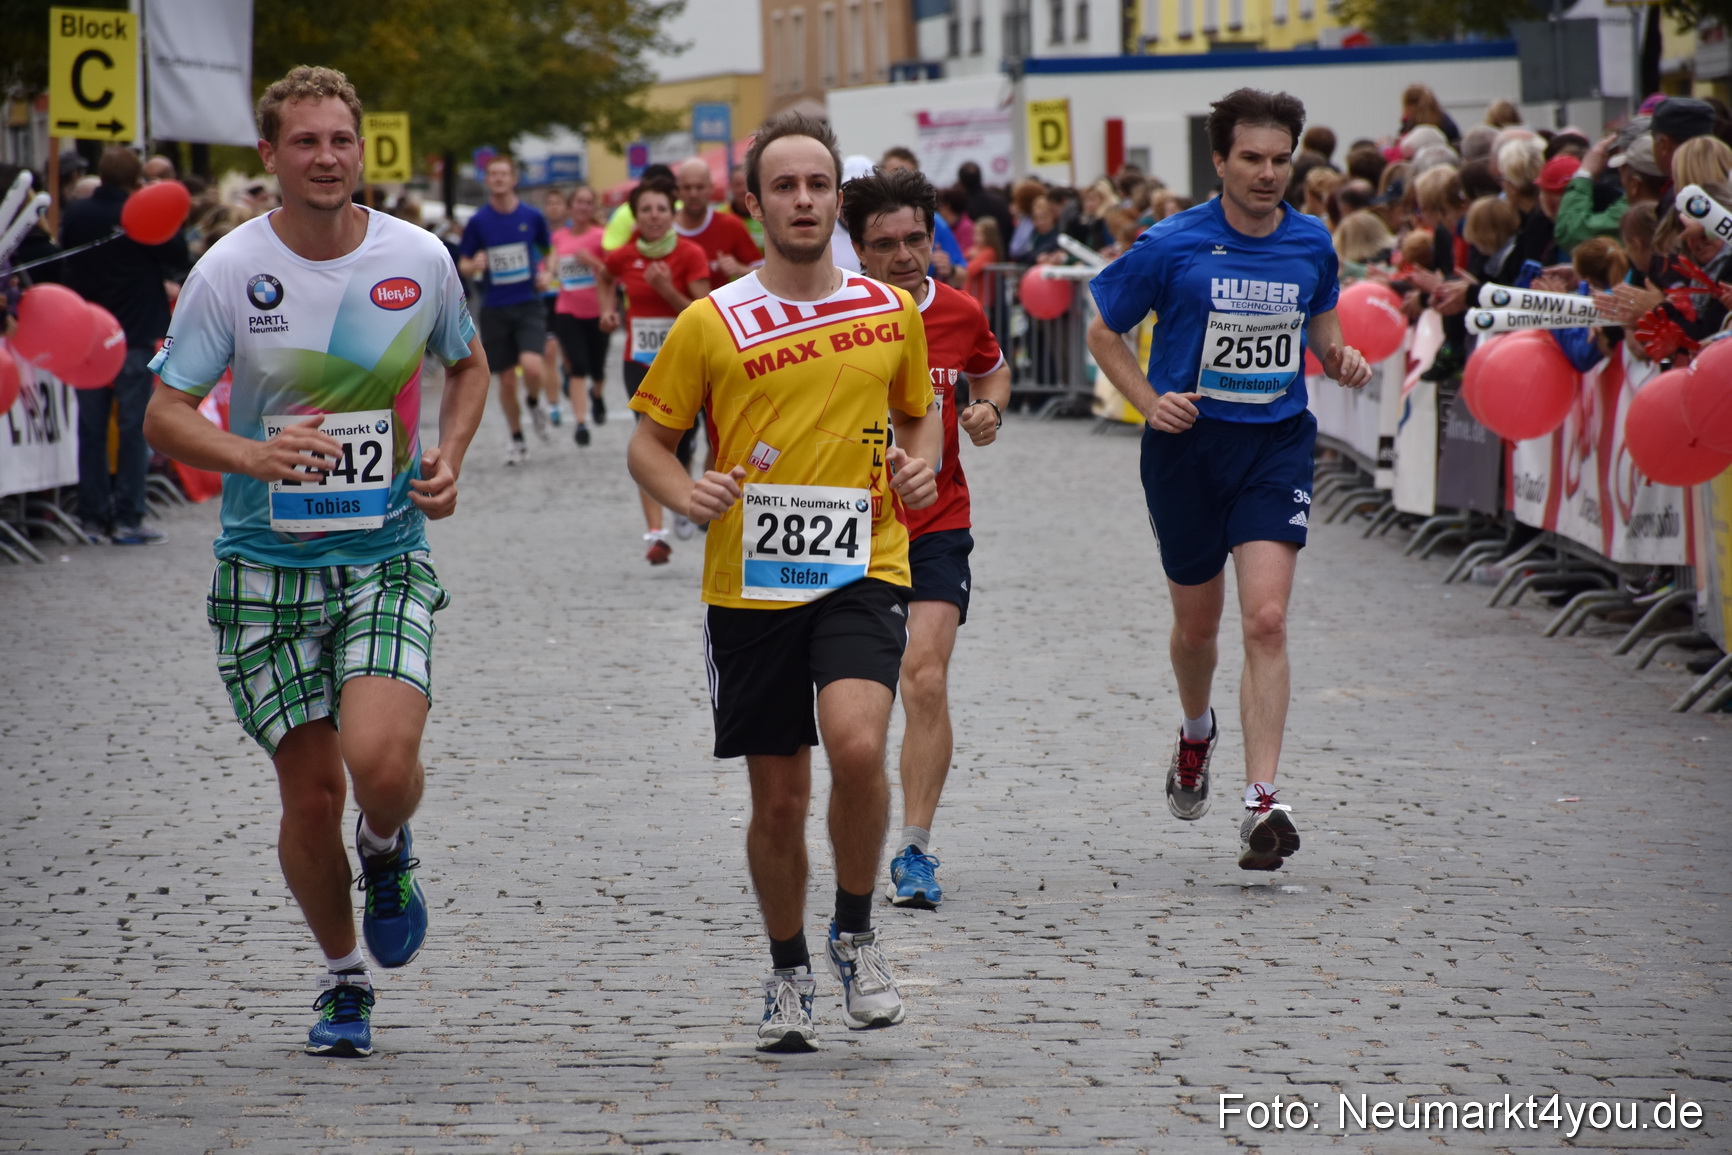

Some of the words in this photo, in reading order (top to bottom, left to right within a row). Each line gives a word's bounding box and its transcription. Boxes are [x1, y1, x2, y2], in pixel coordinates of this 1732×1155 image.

[61, 14, 127, 40] Block
[71, 49, 114, 111] C
[1039, 120, 1062, 151] D
[375, 135, 399, 168] D
[377, 286, 416, 301] Hervis
[1211, 278, 1300, 304] HUBER
[1230, 301, 1294, 313] TECHNOLOGY
[1521, 294, 1565, 313] BMW
[248, 315, 289, 326] PARTL
[1210, 320, 1244, 333] PARTL
[1245, 322, 1288, 333] Neumarkt
[249, 325, 289, 334] Neumarkt
[743, 339, 823, 380] MAX
[829, 322, 905, 353] BÖGL
[1213, 334, 1292, 369] 2550
[1220, 376, 1280, 393] Christoph
[273, 483, 279, 491] C
[746, 495, 787, 507] PARTL
[790, 497, 851, 510] Neumarkt
[1293, 489, 1311, 504] 35
[303, 498, 361, 515] Tobias
[756, 512, 859, 558] 2824
[748, 550, 753, 558] B
[780, 567, 828, 585] Stefan
